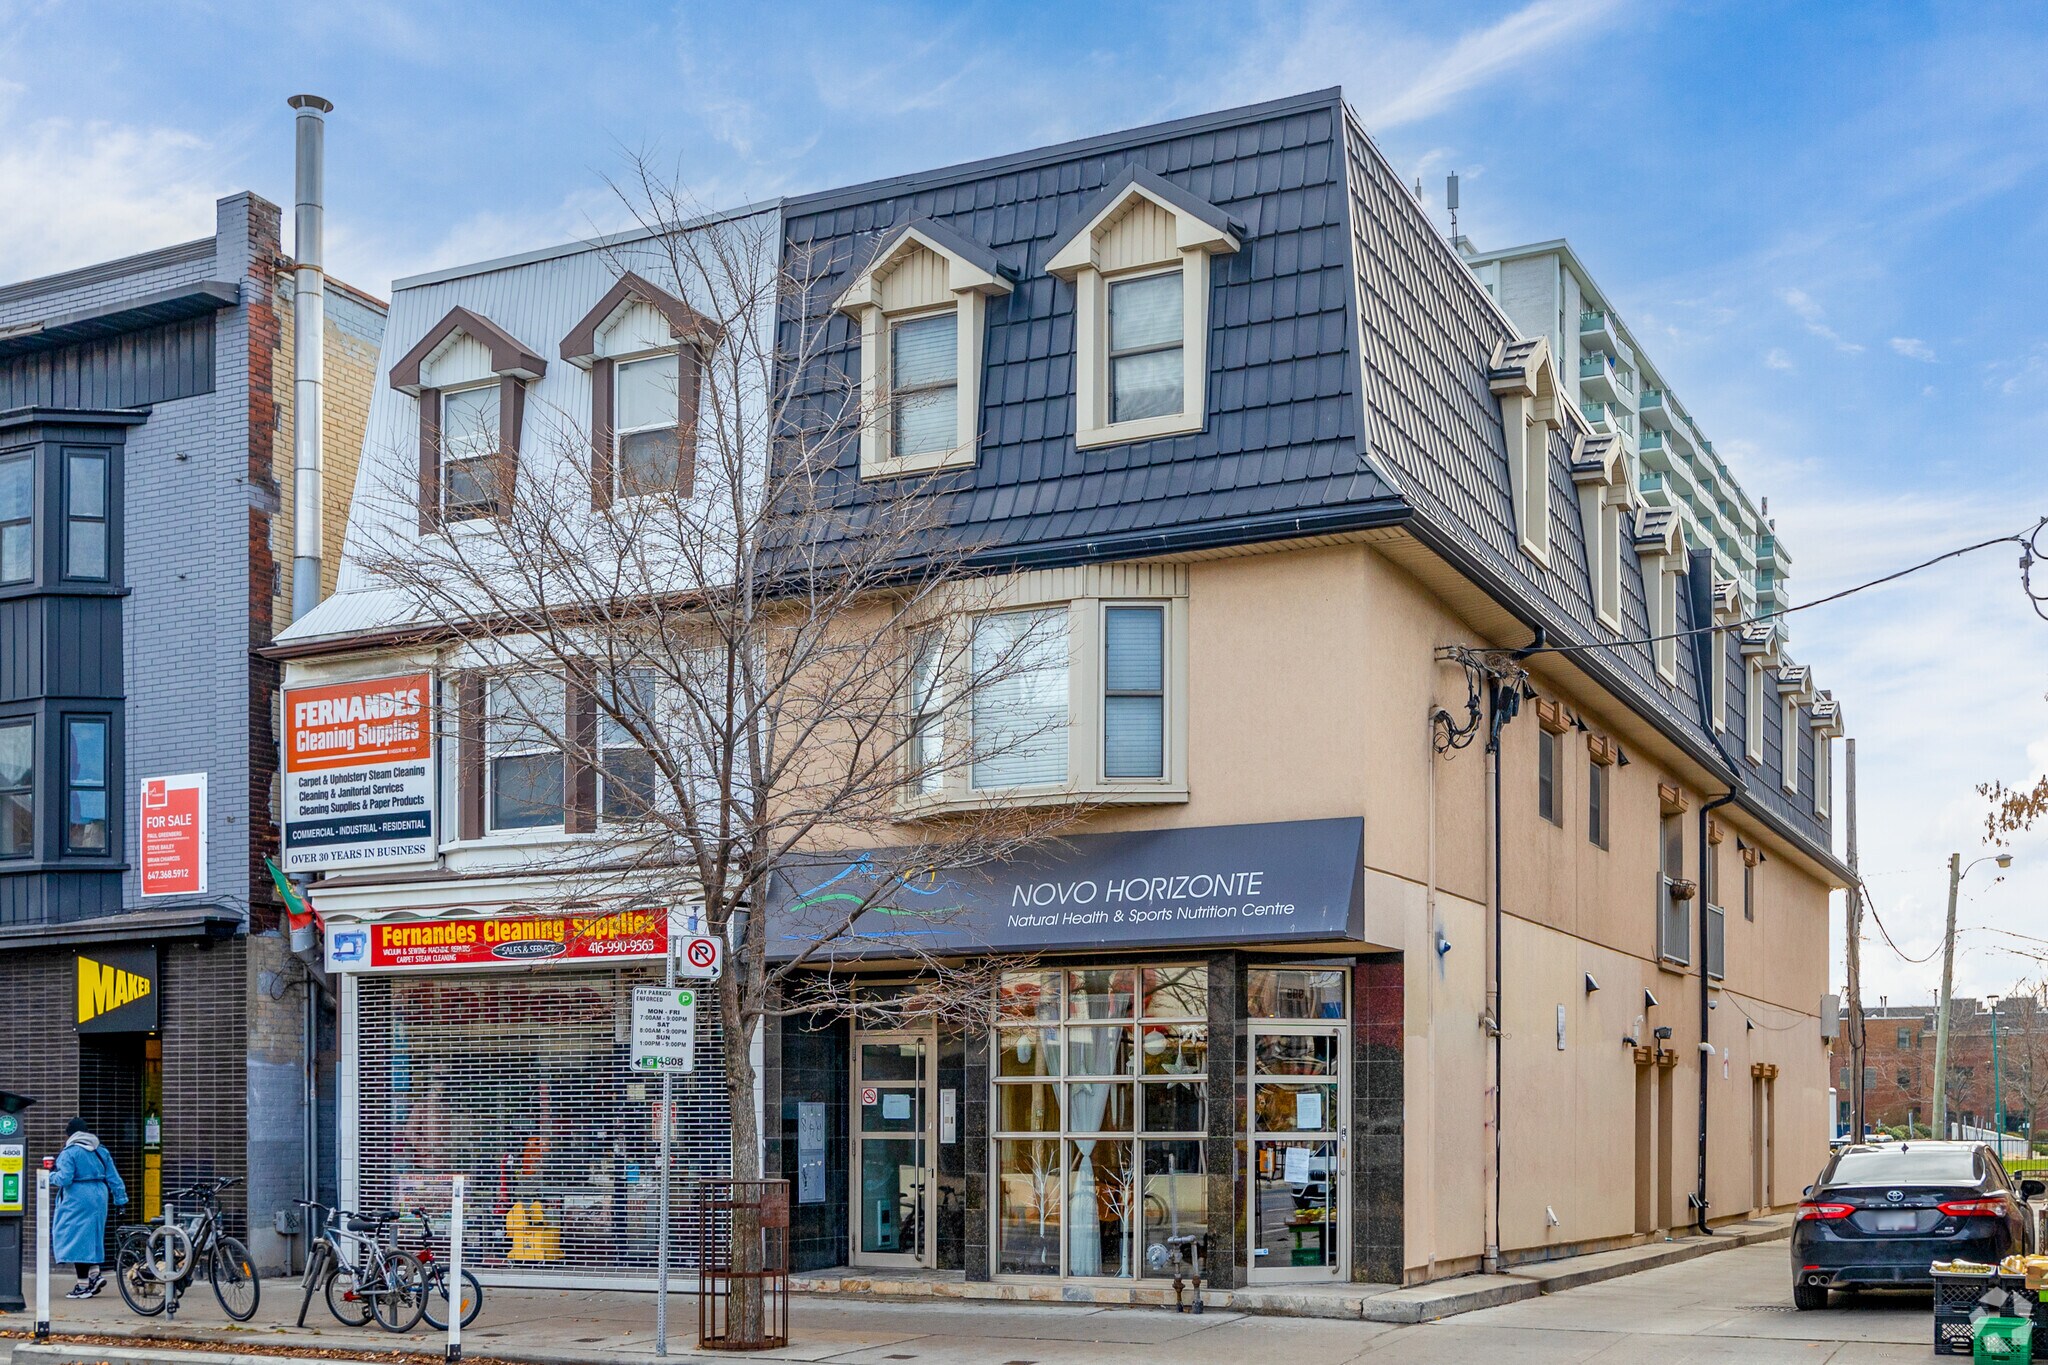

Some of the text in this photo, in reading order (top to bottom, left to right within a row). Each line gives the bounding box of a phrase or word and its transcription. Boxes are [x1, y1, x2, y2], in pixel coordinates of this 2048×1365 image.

[295, 689, 420, 728] FERNANDES
[296, 719, 419, 752] Cleaning Supplies
[298, 766, 425, 788] Carpet & Upholstery Steam Cleaning
[299, 783, 404, 801] Cleaning & Janitorial Services
[300, 795, 424, 816] Cleaning Supplies & Paper Products
[147, 814, 192, 828] FOR SALE
[292, 820, 426, 840] COMMERCIAL INDUSTRIAL RESIDENTIAL
[291, 844, 426, 864] OVER 30 YEARS IN BUSINESS
[147, 869, 188, 880] 647.368.5912
[1012, 871, 1263, 906] NOVO HORIZONTE
[1007, 902, 1295, 927] Natural Health & Sports Nutrition Centre
[382, 922, 477, 947] Fernandes
[483, 918, 565, 943] Cleaning
[502, 946, 522, 955] SALES
[588, 939, 654, 953] 416-990-9563
[78, 956, 151, 1024] MAKER
[658, 1057, 684, 1066] 4808
